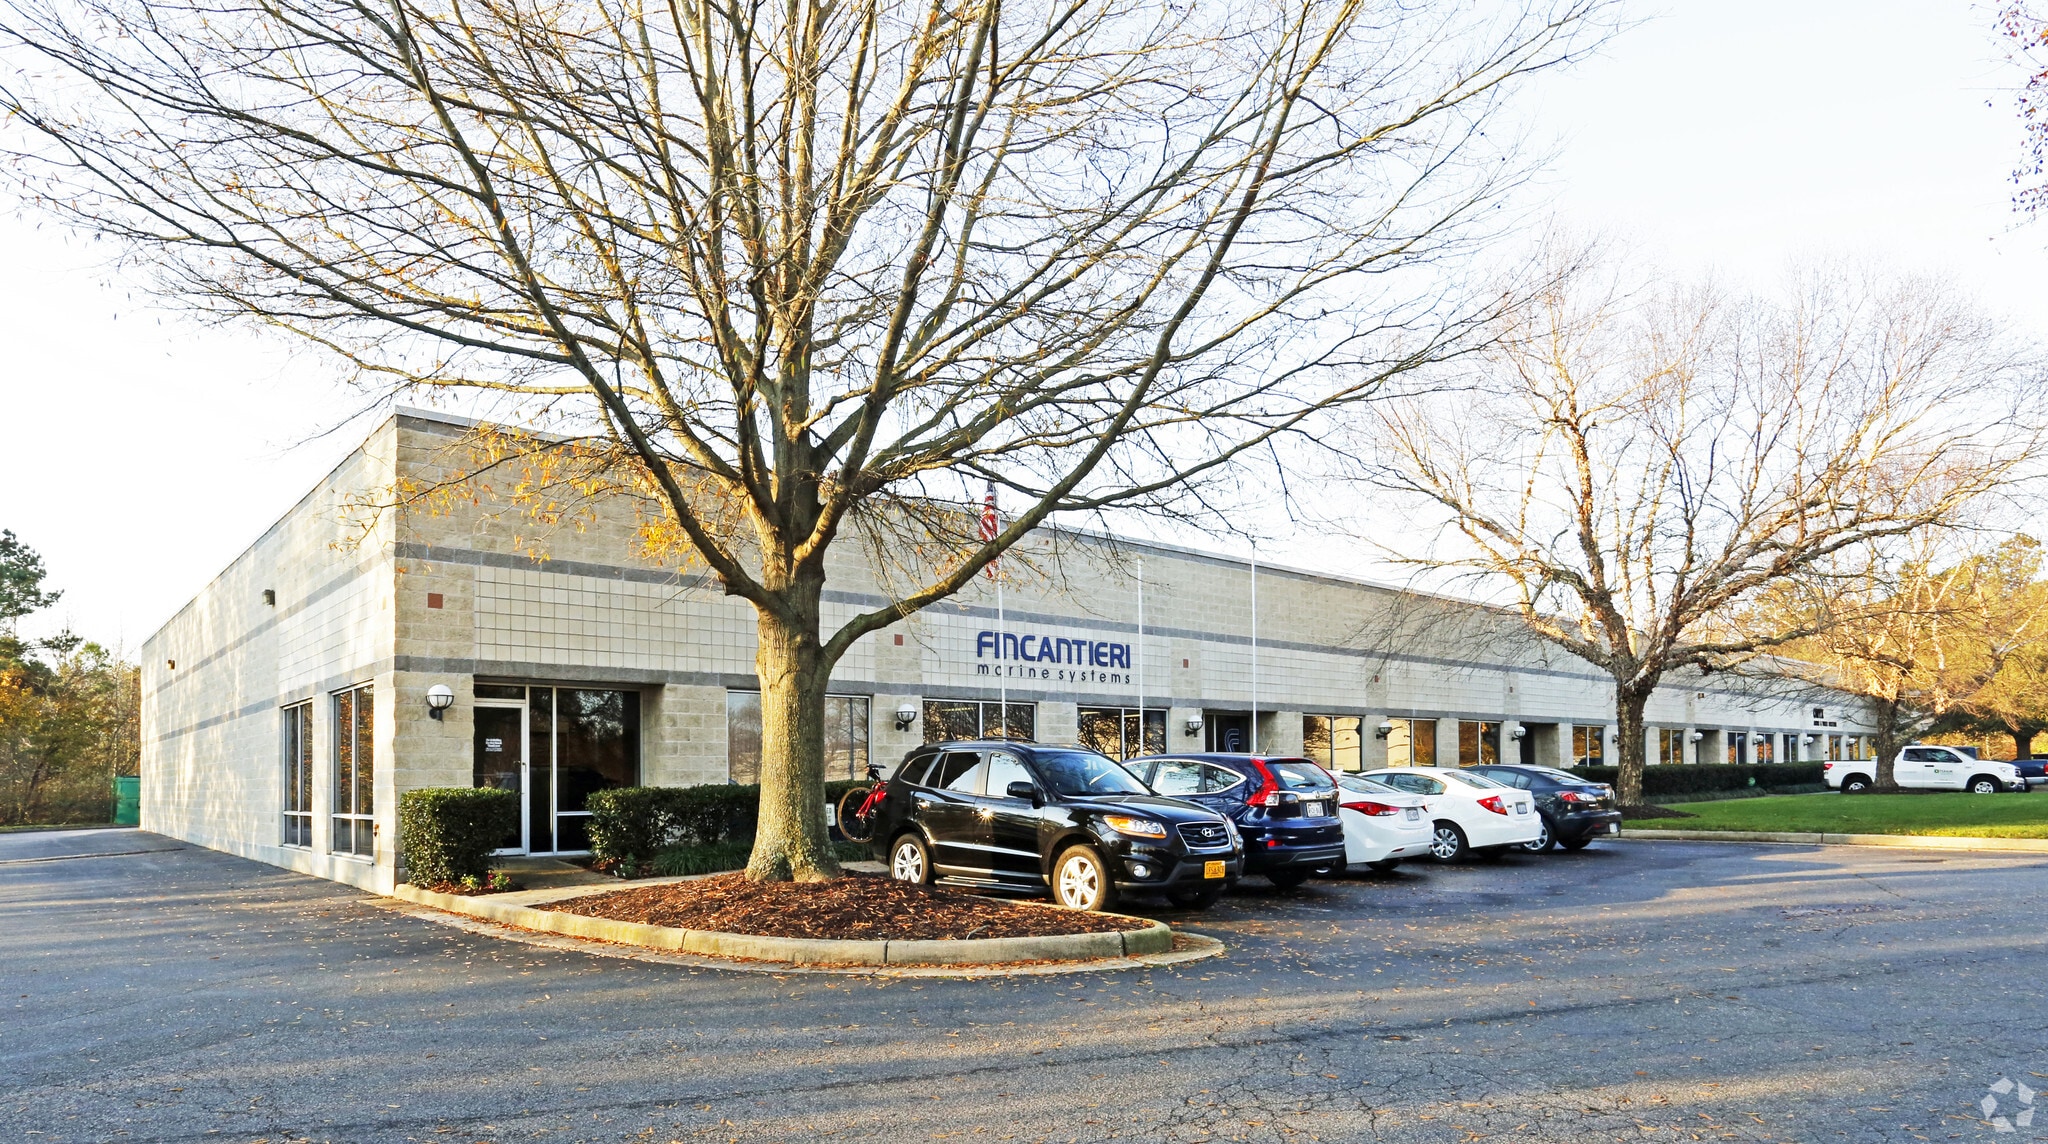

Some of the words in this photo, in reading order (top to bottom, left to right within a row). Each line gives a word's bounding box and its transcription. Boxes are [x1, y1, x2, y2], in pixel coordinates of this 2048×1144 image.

[977, 631, 1131, 669] FINCANTIERI
[978, 663, 1049, 679] marine
[1058, 668, 1131, 684] systems
